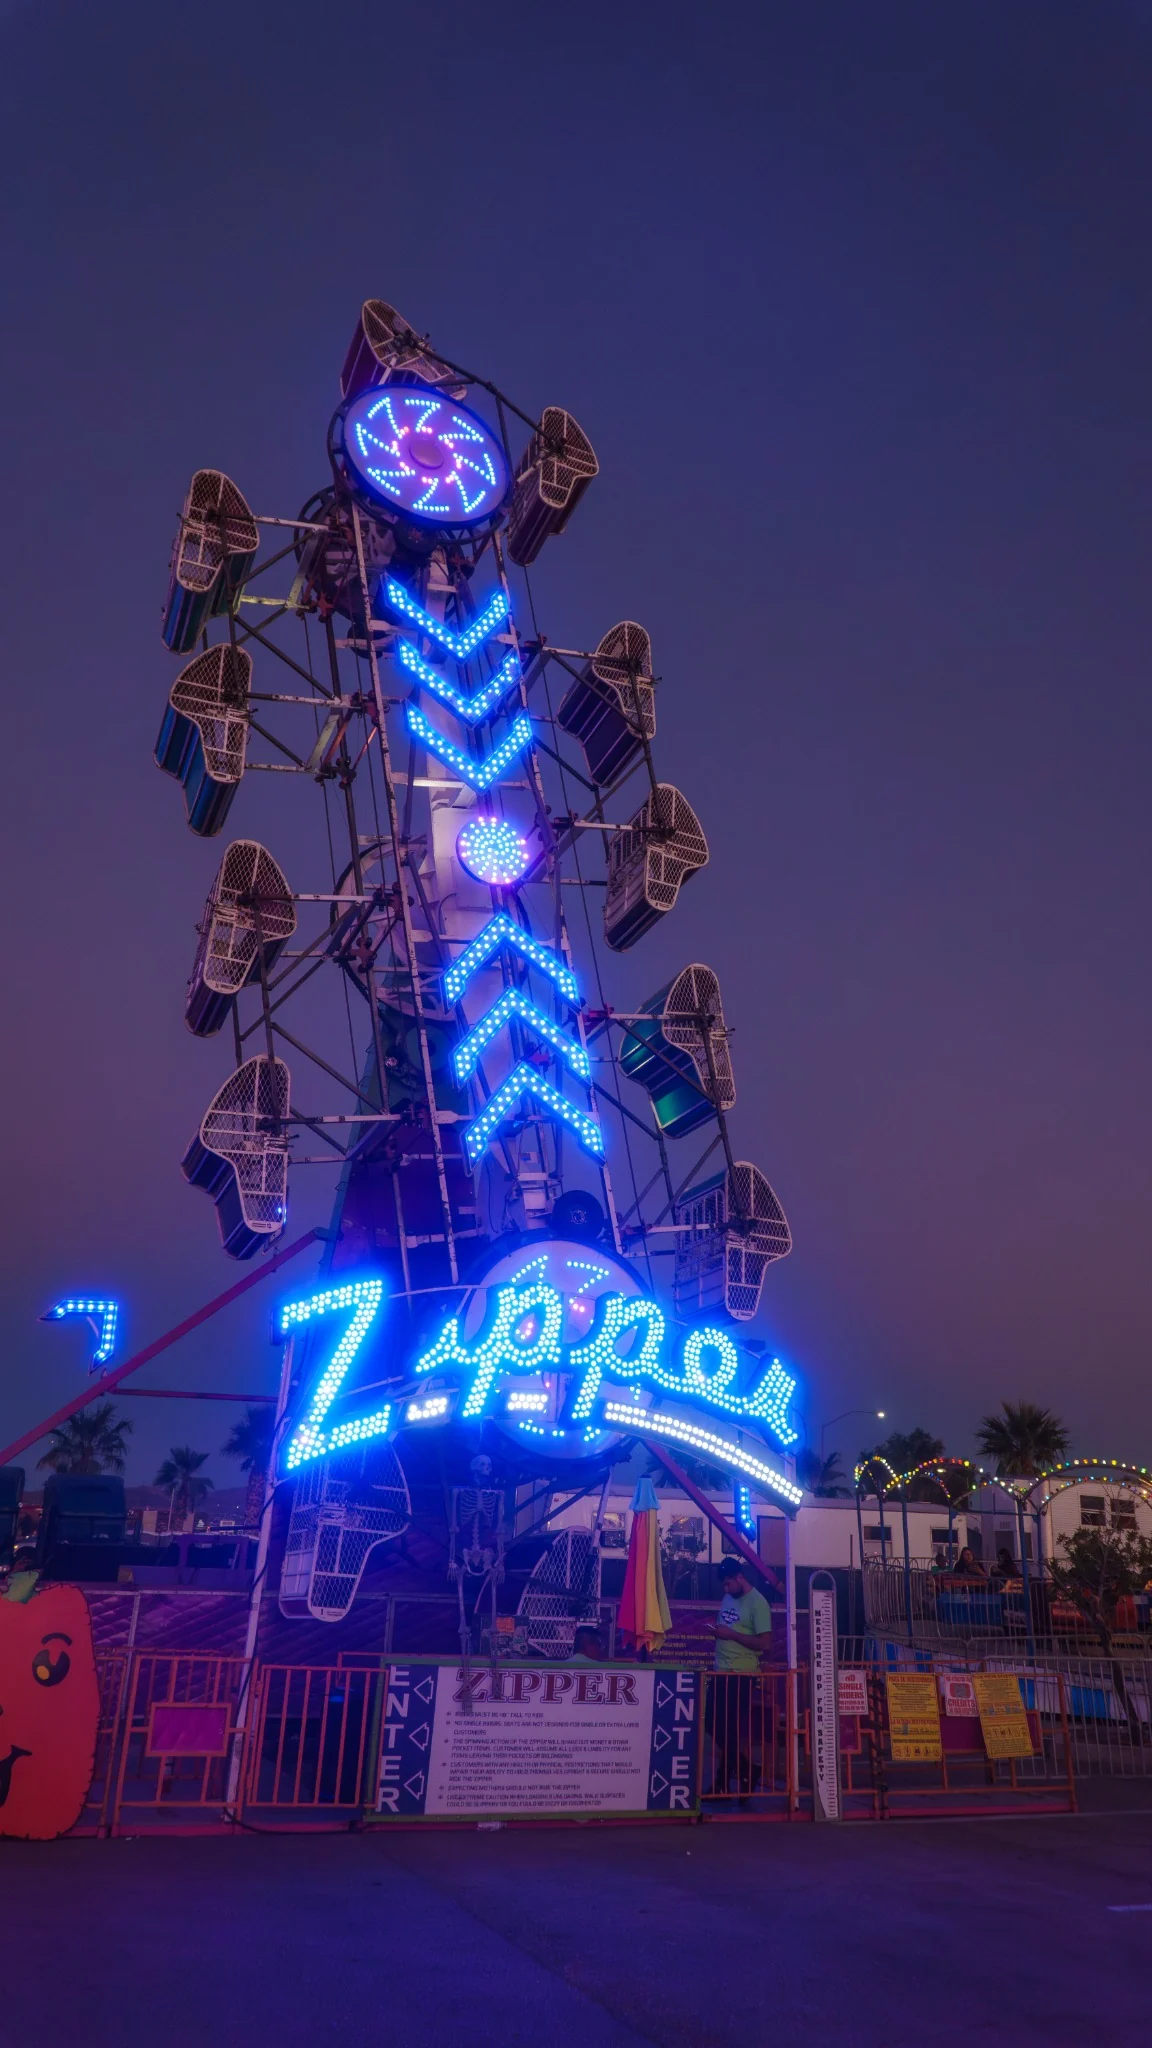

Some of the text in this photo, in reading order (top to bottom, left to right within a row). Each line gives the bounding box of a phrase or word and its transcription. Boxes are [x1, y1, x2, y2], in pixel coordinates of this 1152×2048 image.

[280, 1278, 799, 1471] Zipper
[814, 1609, 822, 1668] MEASURE
[453, 1669, 639, 1705] ZIPPER
[816, 1675, 823, 1691] UP
[838, 1691, 865, 1699] RIDERS
[845, 1674, 856, 1682] NO
[948, 1698, 976, 1708] CREDITS
[375, 1665, 411, 1812] ENTER
[669, 1671, 695, 1809] ENTER
[817, 1729, 825, 1782] SAFETY
